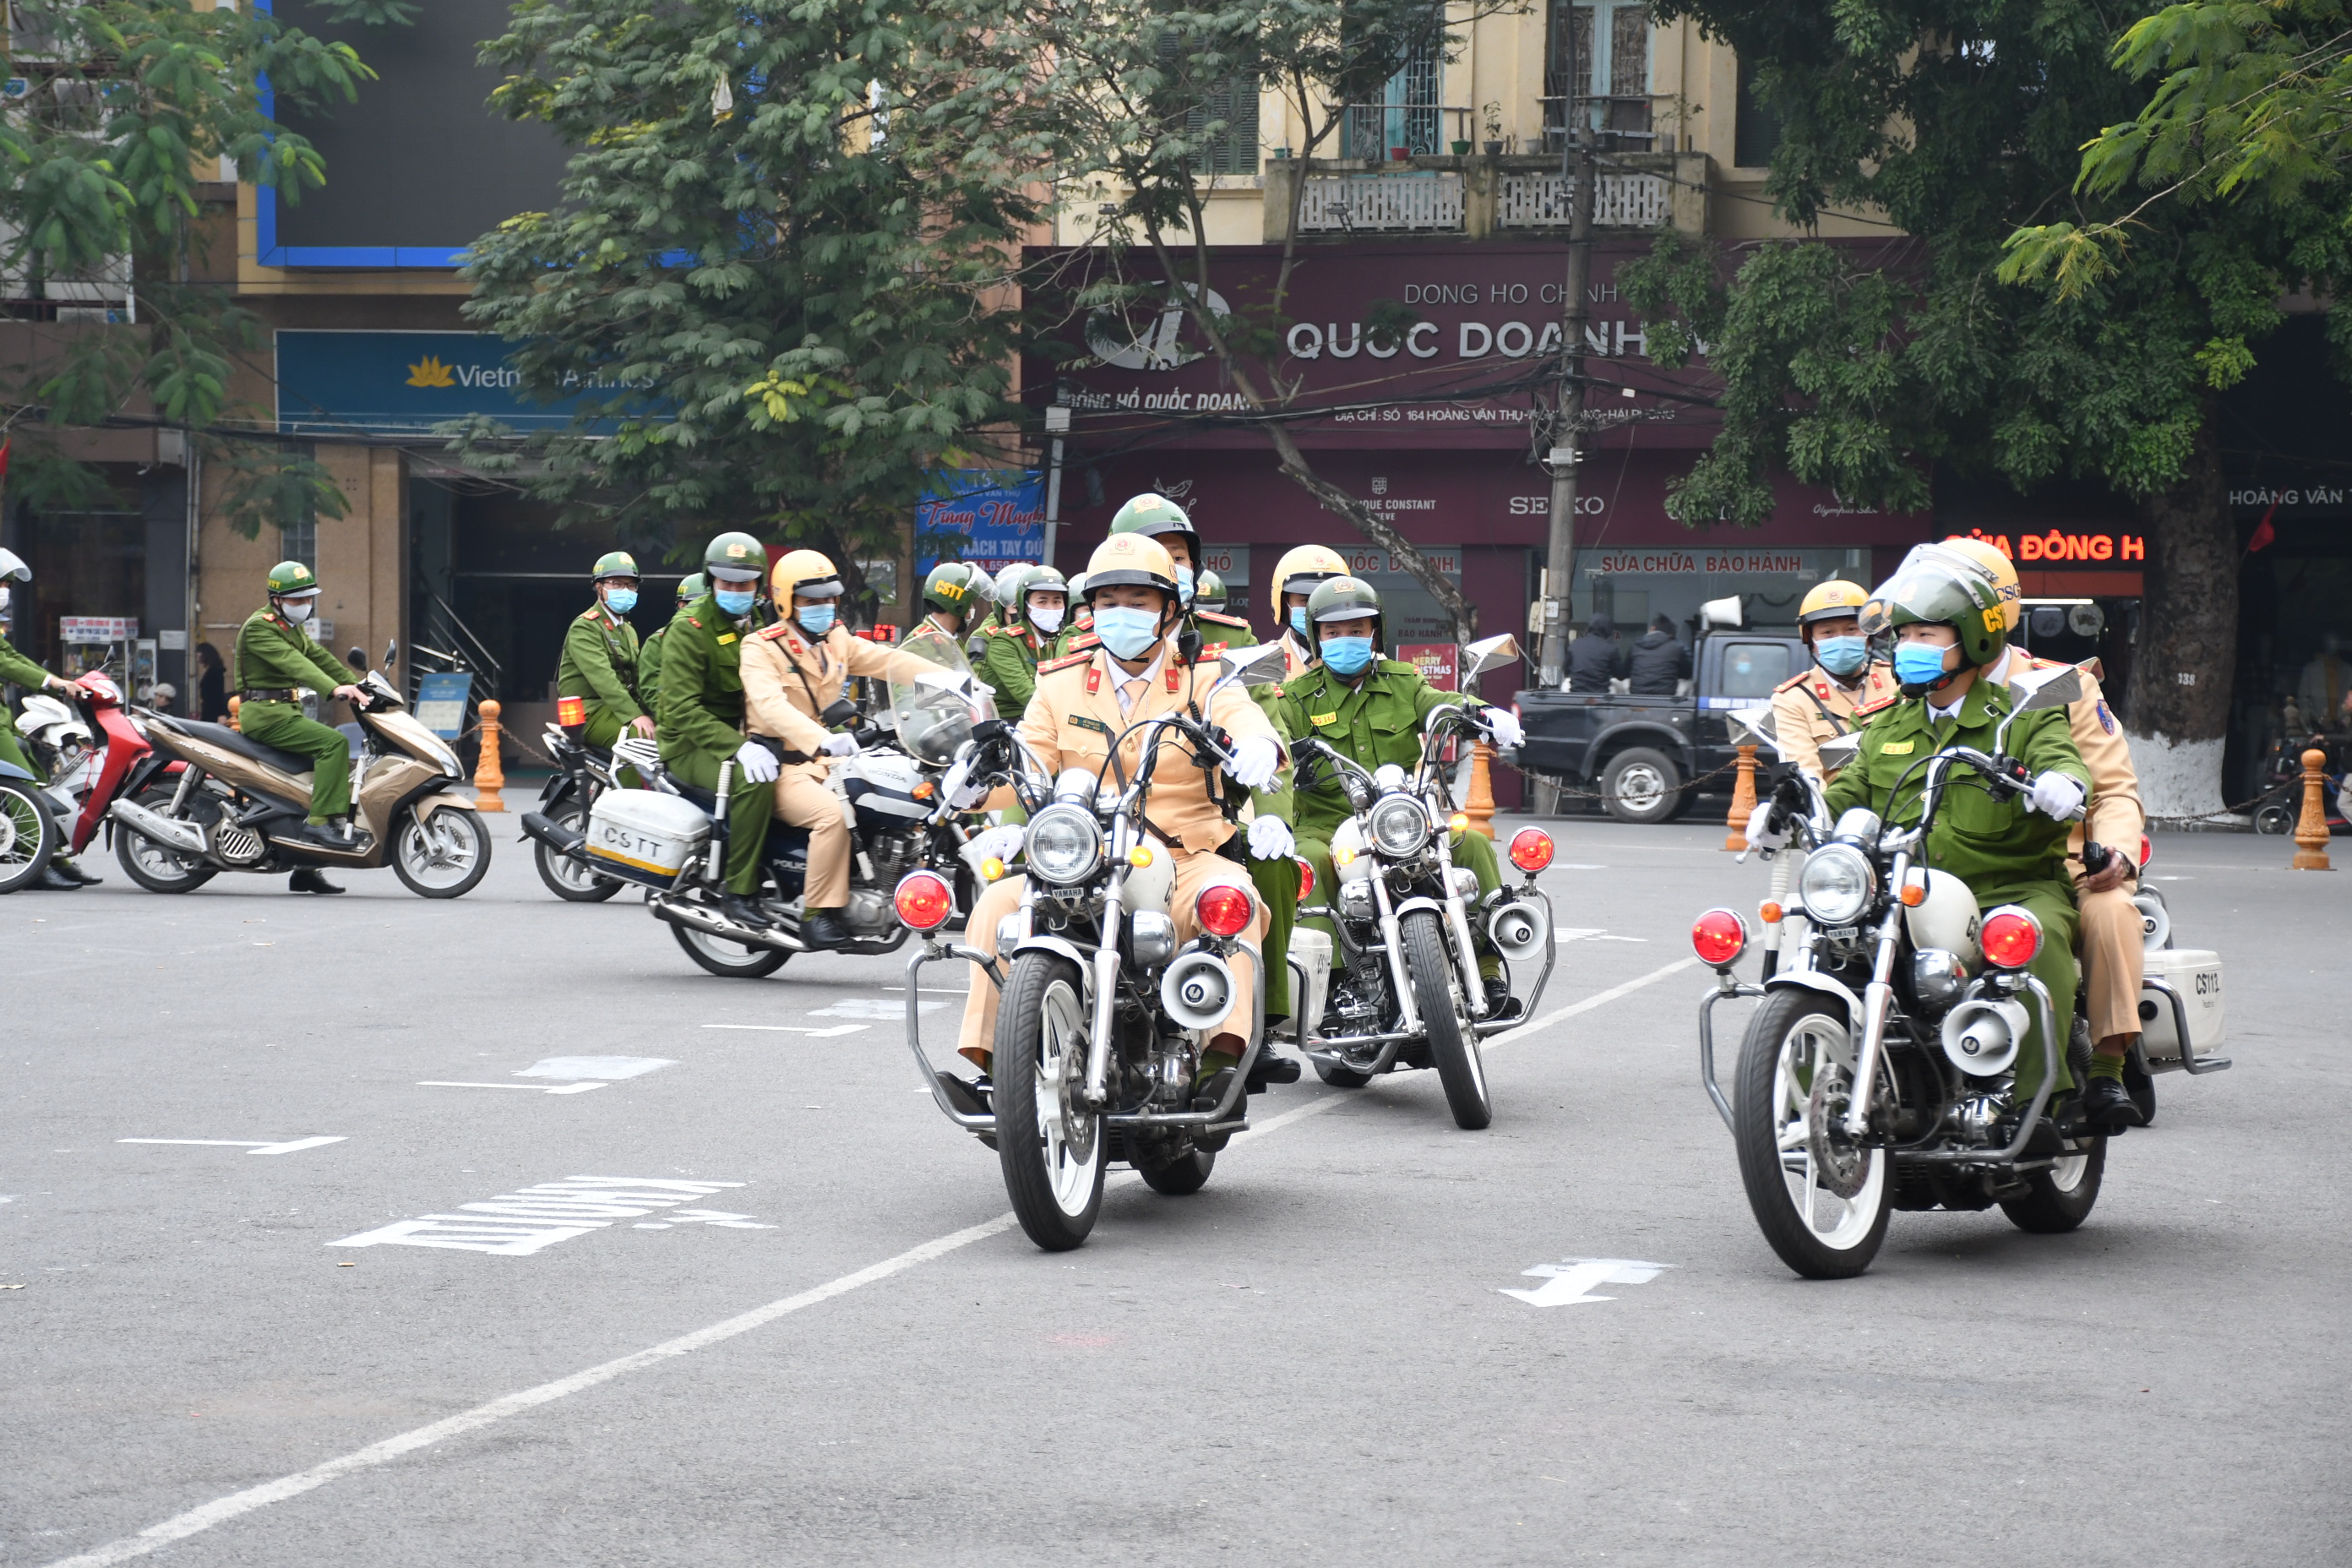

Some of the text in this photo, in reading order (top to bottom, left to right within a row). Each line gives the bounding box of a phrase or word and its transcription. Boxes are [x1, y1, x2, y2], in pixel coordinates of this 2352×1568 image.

[1403, 282, 1618, 304] DONG HO CHNH
[456, 364, 558, 389] Vietn
[1196, 392, 1251, 411] DOAN
[1407, 410, 1424, 421] 164
[1427, 407, 1470, 421] HOÀNG
[1472, 407, 1496, 421] VĂN
[1386, 499, 1436, 509] CONSTANT
[2230, 485, 2344, 506] HOÀNG VĂN
[1509, 496, 1605, 515] SEKO
[920, 499, 976, 536] Trang
[1000, 540, 1021, 556] TAY
[2019, 528, 2114, 560] ĐỒNG
[1206, 549, 1233, 571] HỒ
[1601, 549, 1802, 573] SỬA CHỮA BẢO HÀNH
[934, 579, 966, 601] CSTT
[1412, 656, 1442, 666] MERRY
[604, 826, 663, 858] CSTT
[772, 858, 808, 871] POLIC
[1398, 857, 1422, 868] YAMAHA
[1054, 888, 1083, 899] YAMAHA
[1827, 928, 1859, 939] YAMAHA
